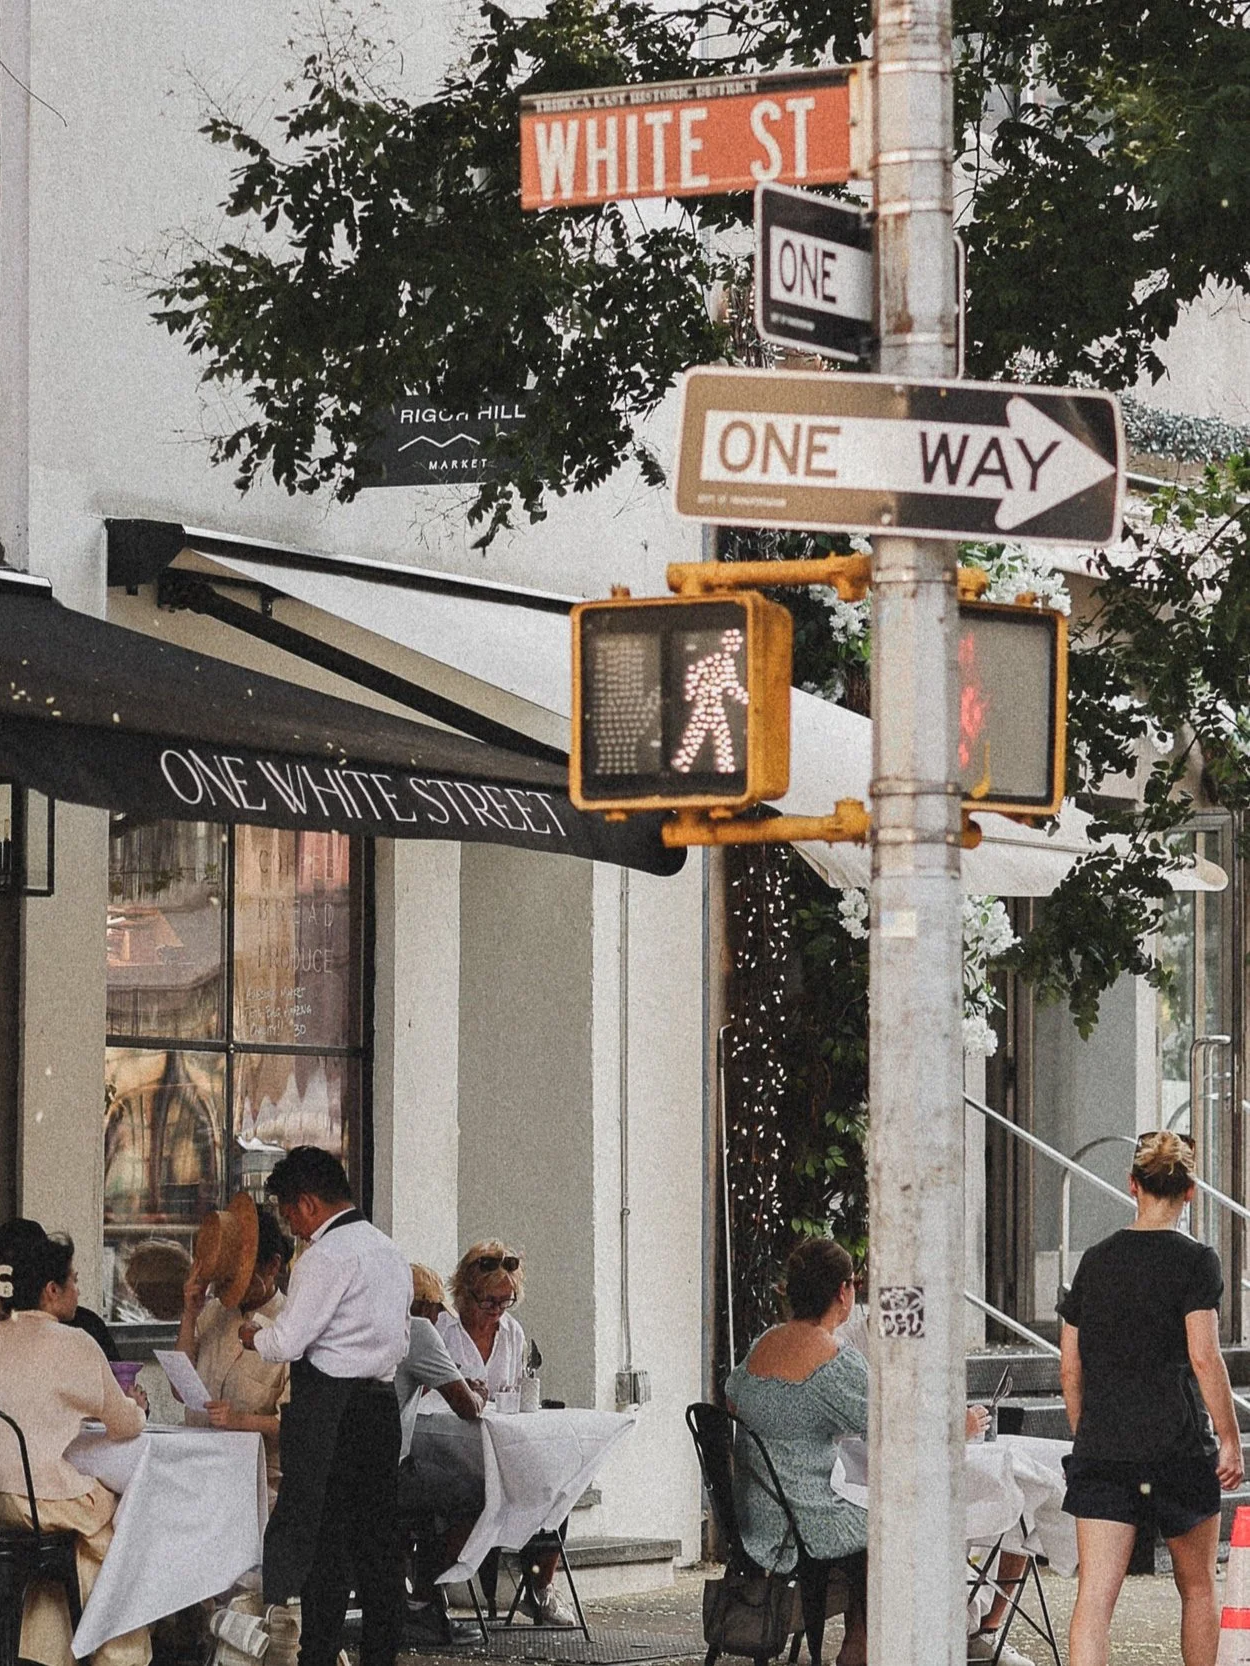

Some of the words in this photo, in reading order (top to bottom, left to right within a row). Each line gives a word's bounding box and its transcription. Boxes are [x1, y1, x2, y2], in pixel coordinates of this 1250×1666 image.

[534, 107, 710, 201] WHITE
[750, 97, 815, 182] ST
[780, 239, 837, 304] ONE
[478, 404, 526, 420] HILL
[428, 458, 488, 470] MARKET
[719, 419, 841, 478] ONE
[919, 431, 1061, 492] WAY
[160, 748, 266, 812] ONE
[256, 760, 417, 823] WHITE
[408, 776, 567, 837] STREET
[257, 945, 335, 974] PRODUCE
